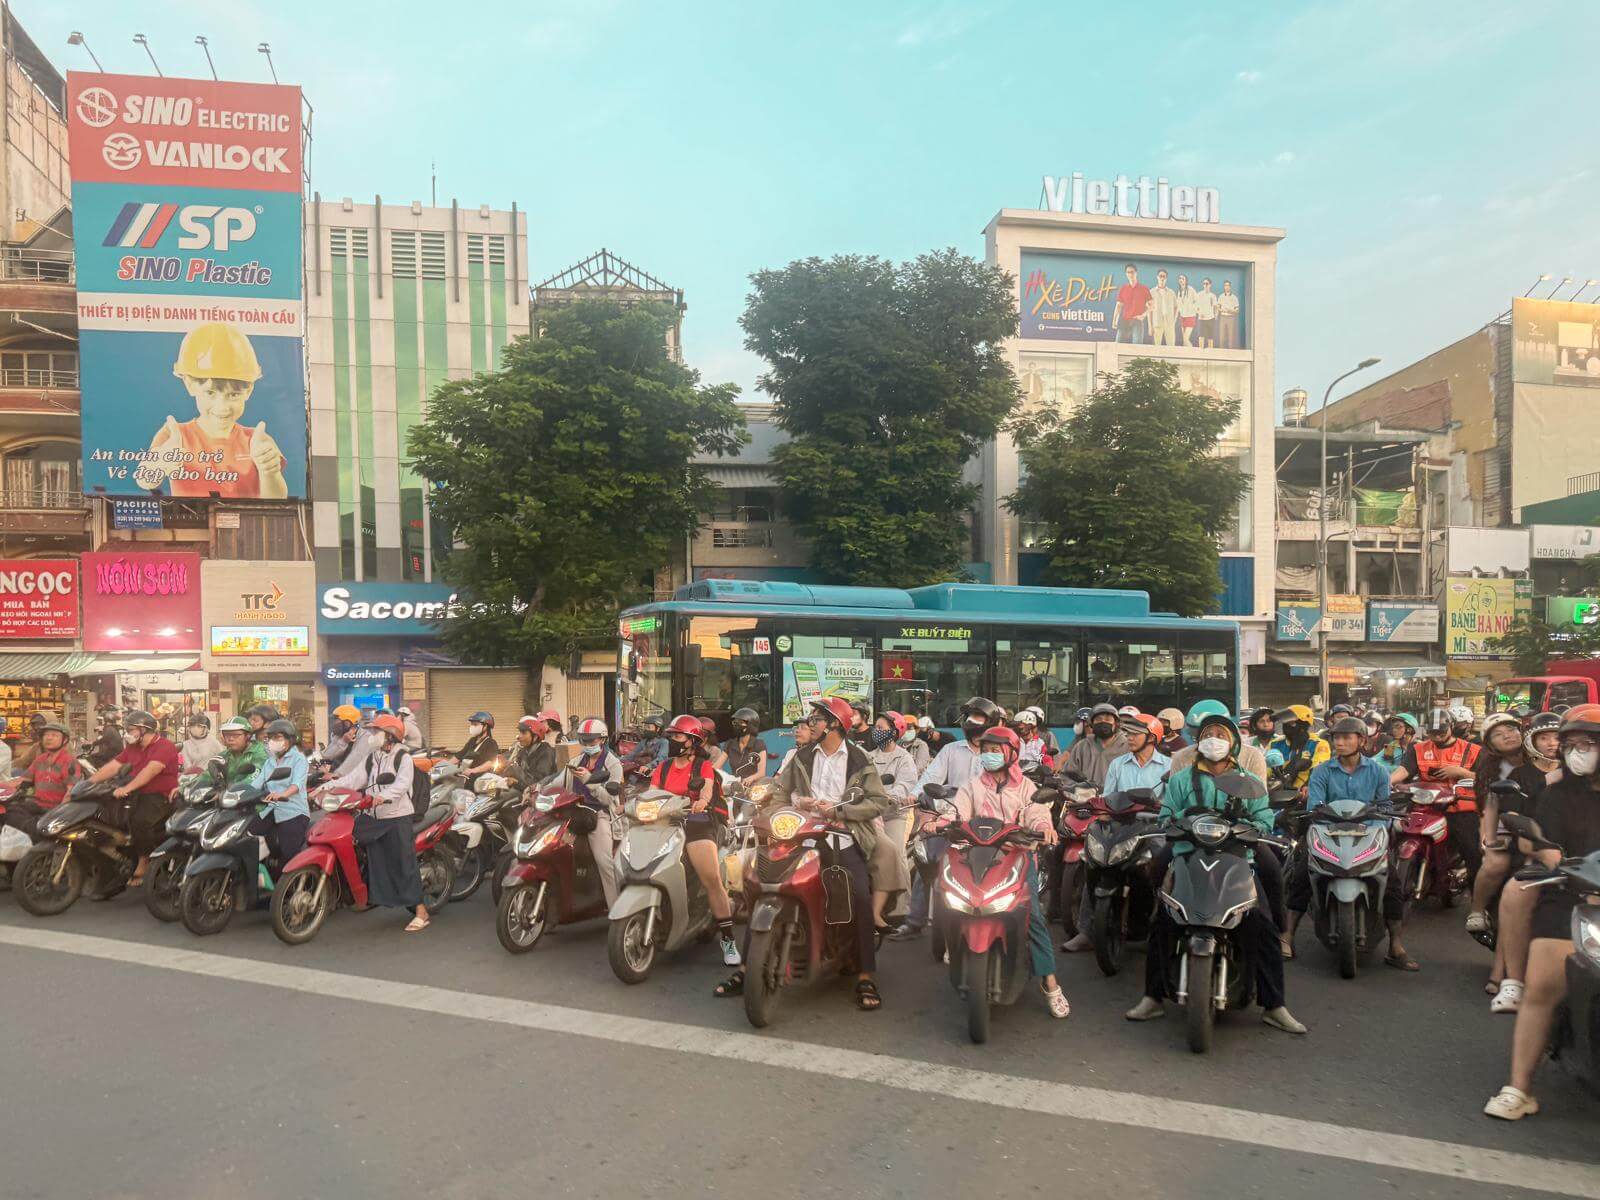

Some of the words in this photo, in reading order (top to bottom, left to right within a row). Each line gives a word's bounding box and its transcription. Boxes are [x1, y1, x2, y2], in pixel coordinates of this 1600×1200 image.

[122, 95, 193, 127] SINO
[198, 108, 291, 133] ELECTRIC
[144, 140, 292, 174] VANLOCK
[1043, 171, 1220, 224] viettien
[178, 204, 257, 252] SP
[117, 255, 182, 282] SINO
[186, 257, 272, 286] Plastic
[79, 302, 113, 318] THIẾT
[116, 306, 129, 321] BỊ
[132, 305, 161, 322] ĐIỆN
[163, 307, 197, 321] DANH
[200, 305, 236, 322] TIẾNG
[238, 306, 269, 324] TOÀN
[90, 448, 113, 461] An
[118, 447, 160, 463] toàn
[163, 448, 194, 463] cho
[132, 465, 165, 484] đẹp
[170, 464, 200, 481] cho
[205, 466, 239, 484] bạn
[116, 500, 159, 509] PACIFIC
[0, 571, 72, 600] NGỌC
[143, 560, 188, 595] SƠN
[3, 601, 24, 609] MUA
[241, 593, 276, 610] TTC
[901, 628, 916, 637] XE
[917, 626, 946, 638] BUÝT
[1372, 623, 1393, 637] Tiger
[755, 640, 769, 652] 145
[327, 668, 391, 679] Sacombank
[825, 667, 864, 676] MultiGo
